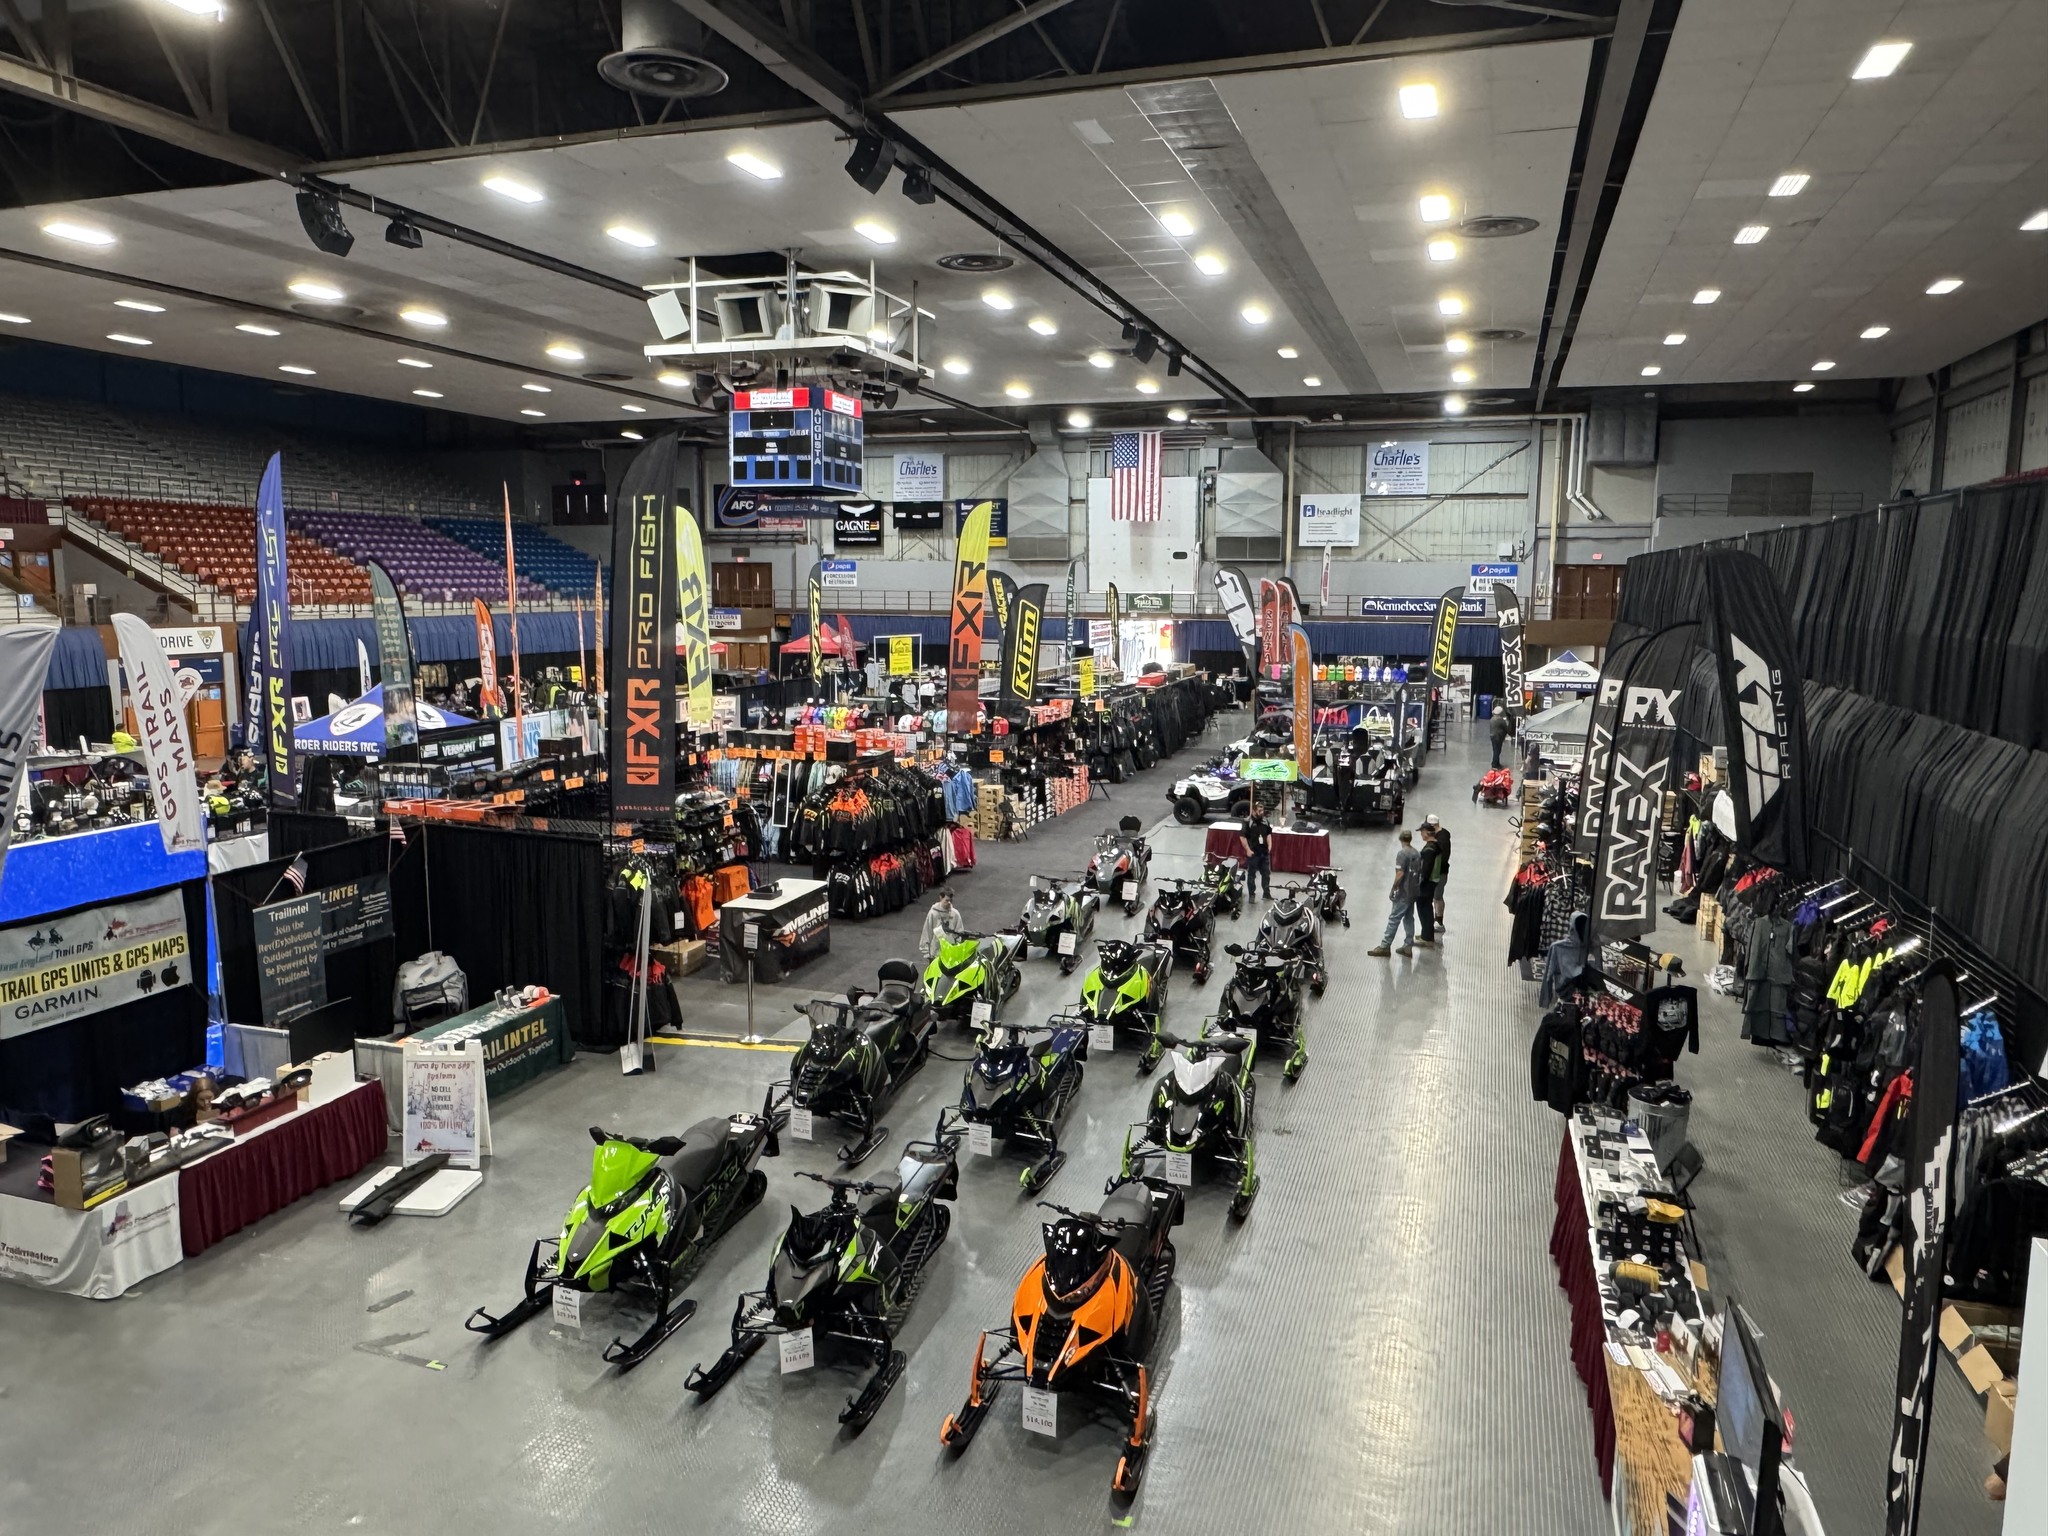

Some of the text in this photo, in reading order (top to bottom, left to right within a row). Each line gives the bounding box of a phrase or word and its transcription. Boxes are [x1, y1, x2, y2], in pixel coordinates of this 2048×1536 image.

[900, 460, 937, 476] Charlie's
[1374, 449, 1421, 466] Charlie's
[731, 501, 754, 510] AFC
[1317, 507, 1353, 518] headlight
[835, 520, 870, 531] GAGNE
[638, 494, 656, 668] PRO FISH
[1488, 566, 1511, 574] pepsi
[952, 560, 986, 670] FXR
[160, 635, 194, 649] DRIVE
[1015, 609, 1037, 694] Klim
[1434, 606, 1457, 675] Klim
[269, 676, 288, 757] FXR
[627, 678, 660, 764] FXR
[1772, 669, 1791, 780] RACING
[136, 661, 178, 821] GPS TRAIL
[159, 687, 188, 773] MAPS
[322, 740, 358, 752] RIDERS
[360, 742, 380, 754] INC.
[441, 740, 476, 758] VERMONT
[508, 731, 541, 761] TNS
[1600, 752, 1670, 921] RAVEX
[268, 902, 309, 922] TrailIntel
[292, 920, 305, 930] the
[262, 941, 317, 965] Outdoor Travel
[276, 955, 308, 972] Powered
[309, 953, 318, 965] by
[1, 935, 185, 1003] TRAIL GPS UNITS & GPS MAPS
[15, 985, 99, 1020] GARMIN
[413, 1062, 429, 1070] Turn
[440, 1062, 457, 1070] Turn
[420, 1121, 464, 1130] 100% OFFLINE
